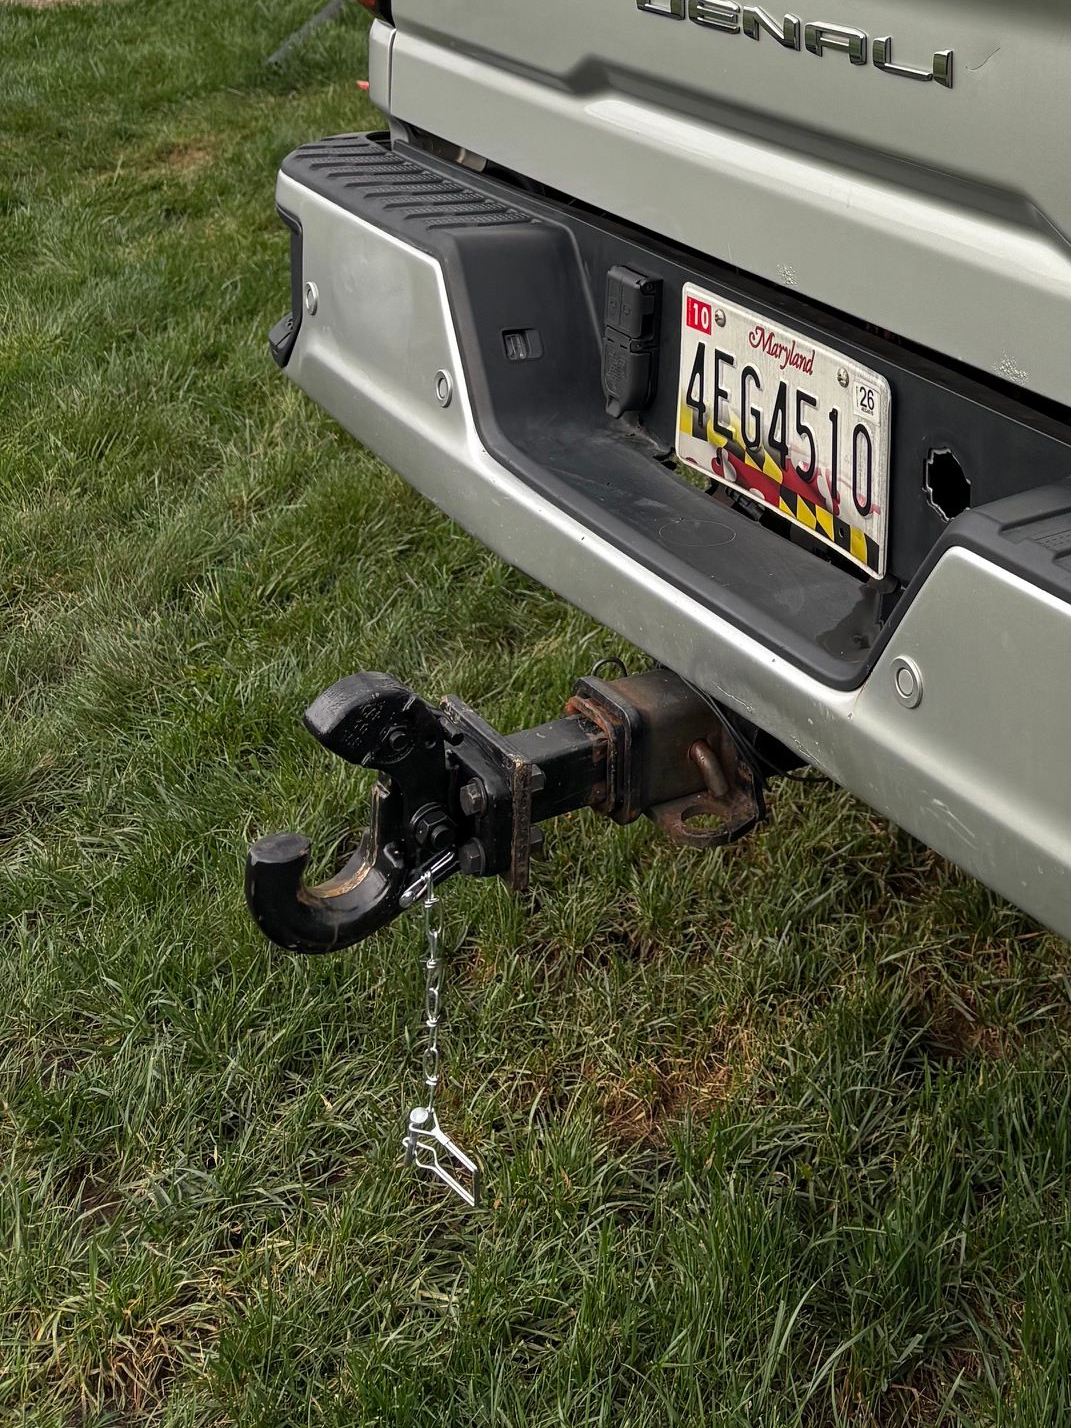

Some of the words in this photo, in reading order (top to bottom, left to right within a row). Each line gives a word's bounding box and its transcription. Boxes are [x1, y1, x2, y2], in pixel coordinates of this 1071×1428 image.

[693, 302, 709, 330] 10
[749, 325, 815, 376] Maryland
[859, 386, 875, 411] 26
[685, 341, 873, 518] 4EG4510
